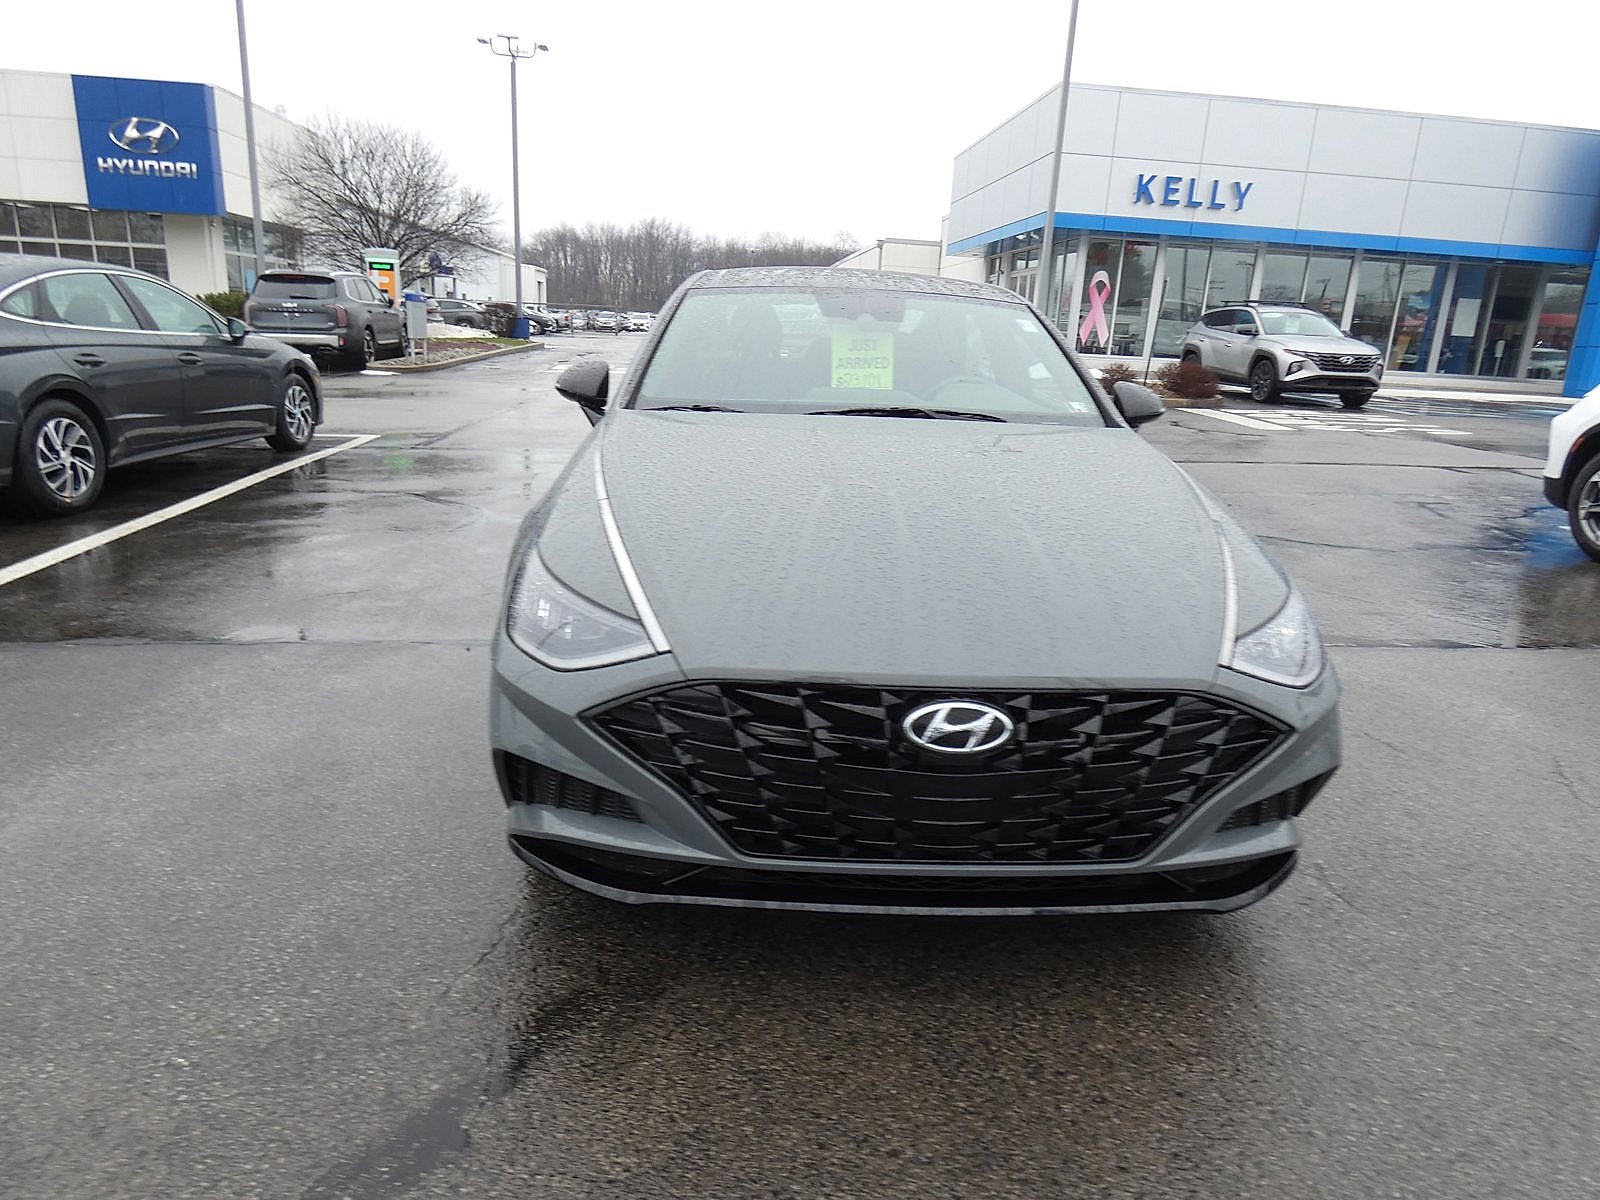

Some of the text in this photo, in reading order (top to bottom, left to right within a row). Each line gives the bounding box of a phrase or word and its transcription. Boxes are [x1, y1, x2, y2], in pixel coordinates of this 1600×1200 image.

[97, 156, 198, 180] HYUNDAI
[1132, 173, 1254, 212] KELLY
[847, 338, 877, 352] JUST
[836, 356, 889, 370] ARRIVED
